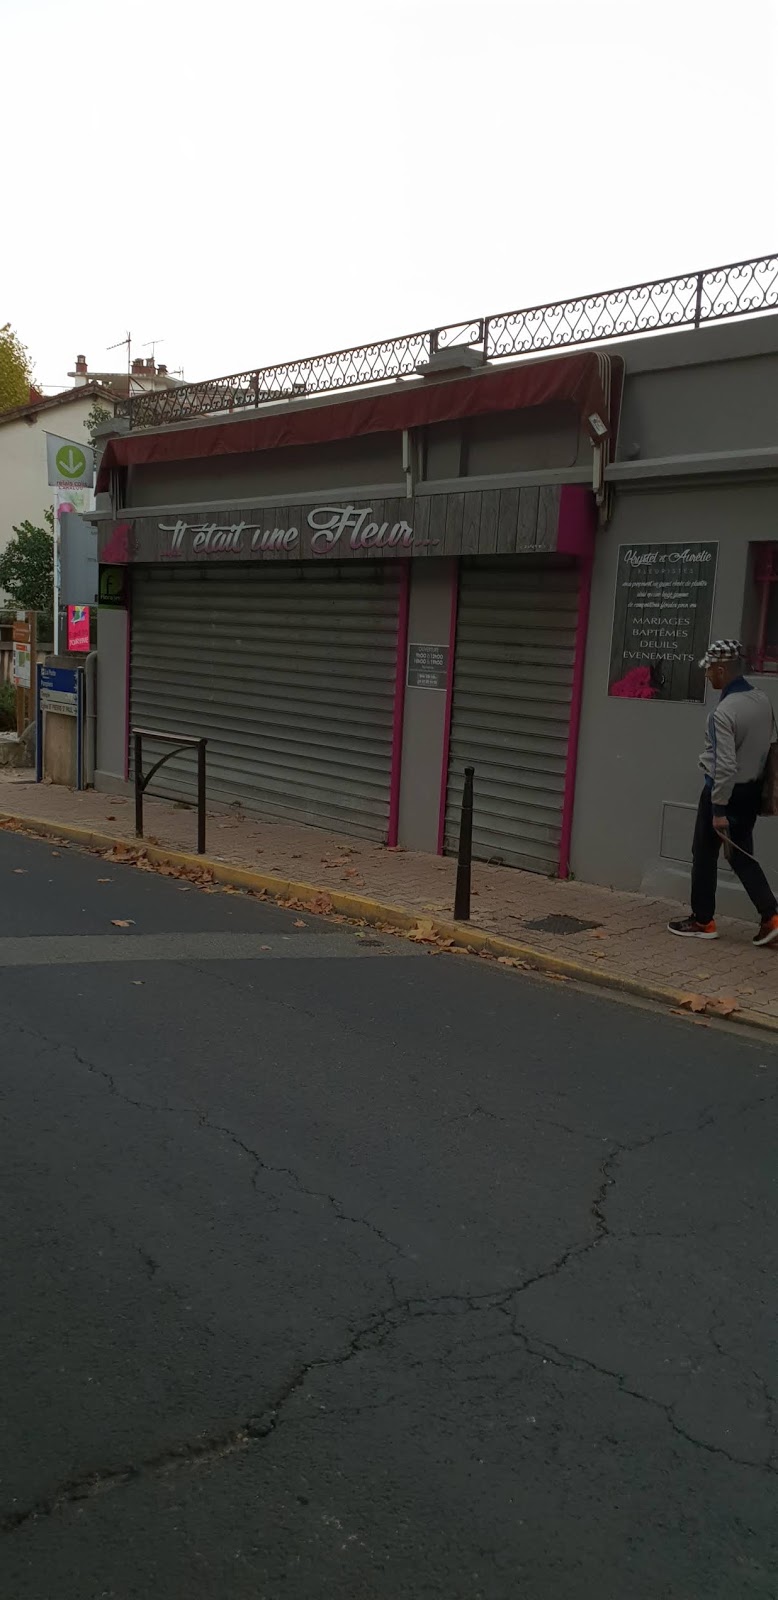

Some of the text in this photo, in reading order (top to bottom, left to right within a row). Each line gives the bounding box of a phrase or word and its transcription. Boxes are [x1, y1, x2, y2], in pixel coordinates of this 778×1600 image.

[191, 521, 260, 554] était
[251, 525, 298, 552] une
[623, 549, 659, 568] Krystel
[668, 548, 712, 564] Aurélie
[632, 617, 690, 625] MARIAGES
[632, 627, 688, 637] BAPTÊMES
[639, 640, 678, 649] DEUILS
[623, 650, 695, 661] EVENEMENTS
